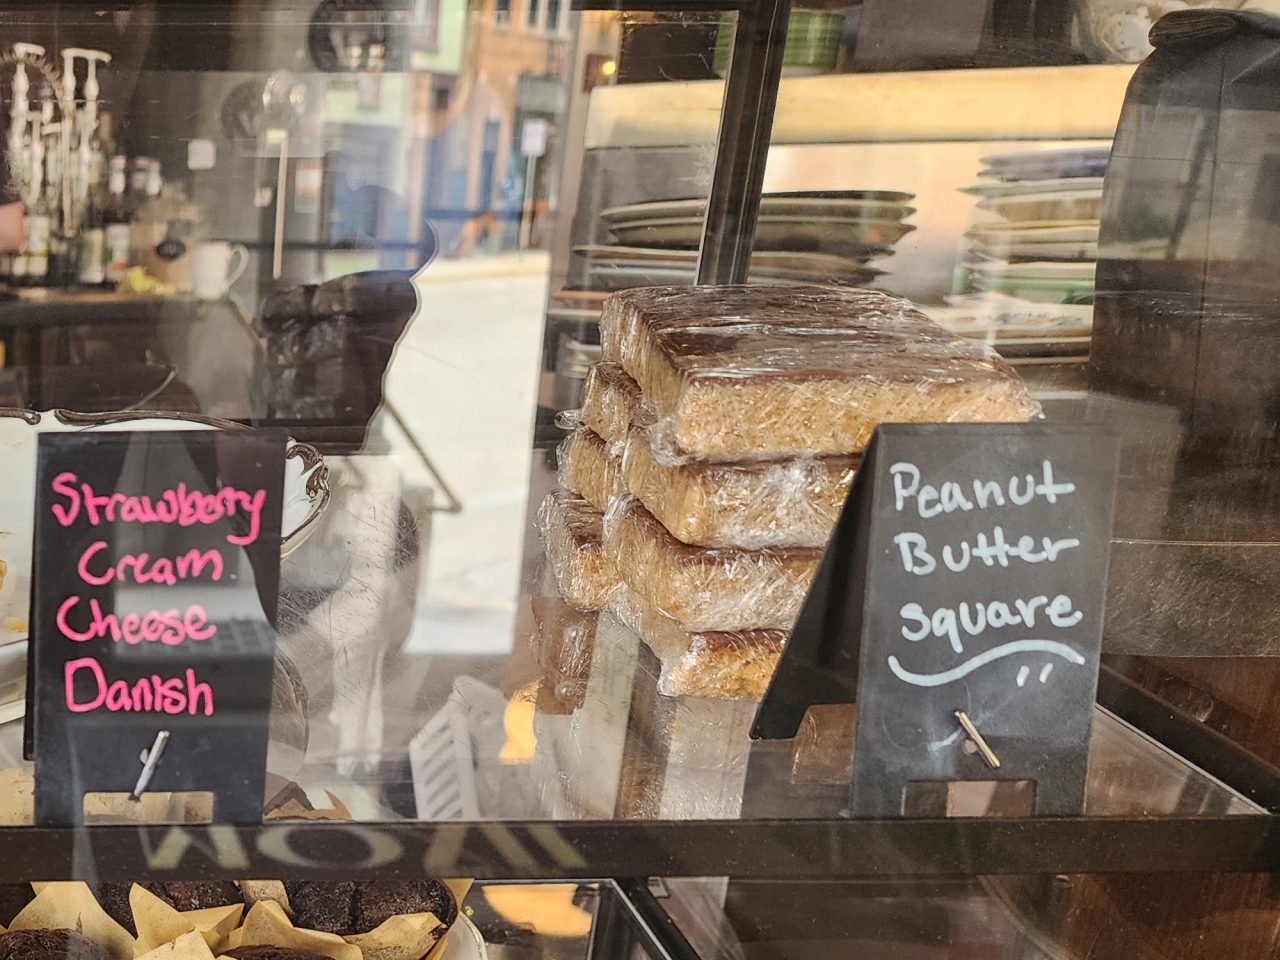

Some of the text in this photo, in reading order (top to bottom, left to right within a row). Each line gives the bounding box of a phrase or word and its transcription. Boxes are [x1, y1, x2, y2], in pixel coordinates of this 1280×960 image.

[51, 471, 267, 546] Strawberry
[889, 459, 1076, 519] Peanut
[77, 541, 225, 586] Cream
[893, 526, 1080, 576] Butter
[56, 595, 217, 646] Cheese
[64, 657, 214, 716] Danish
